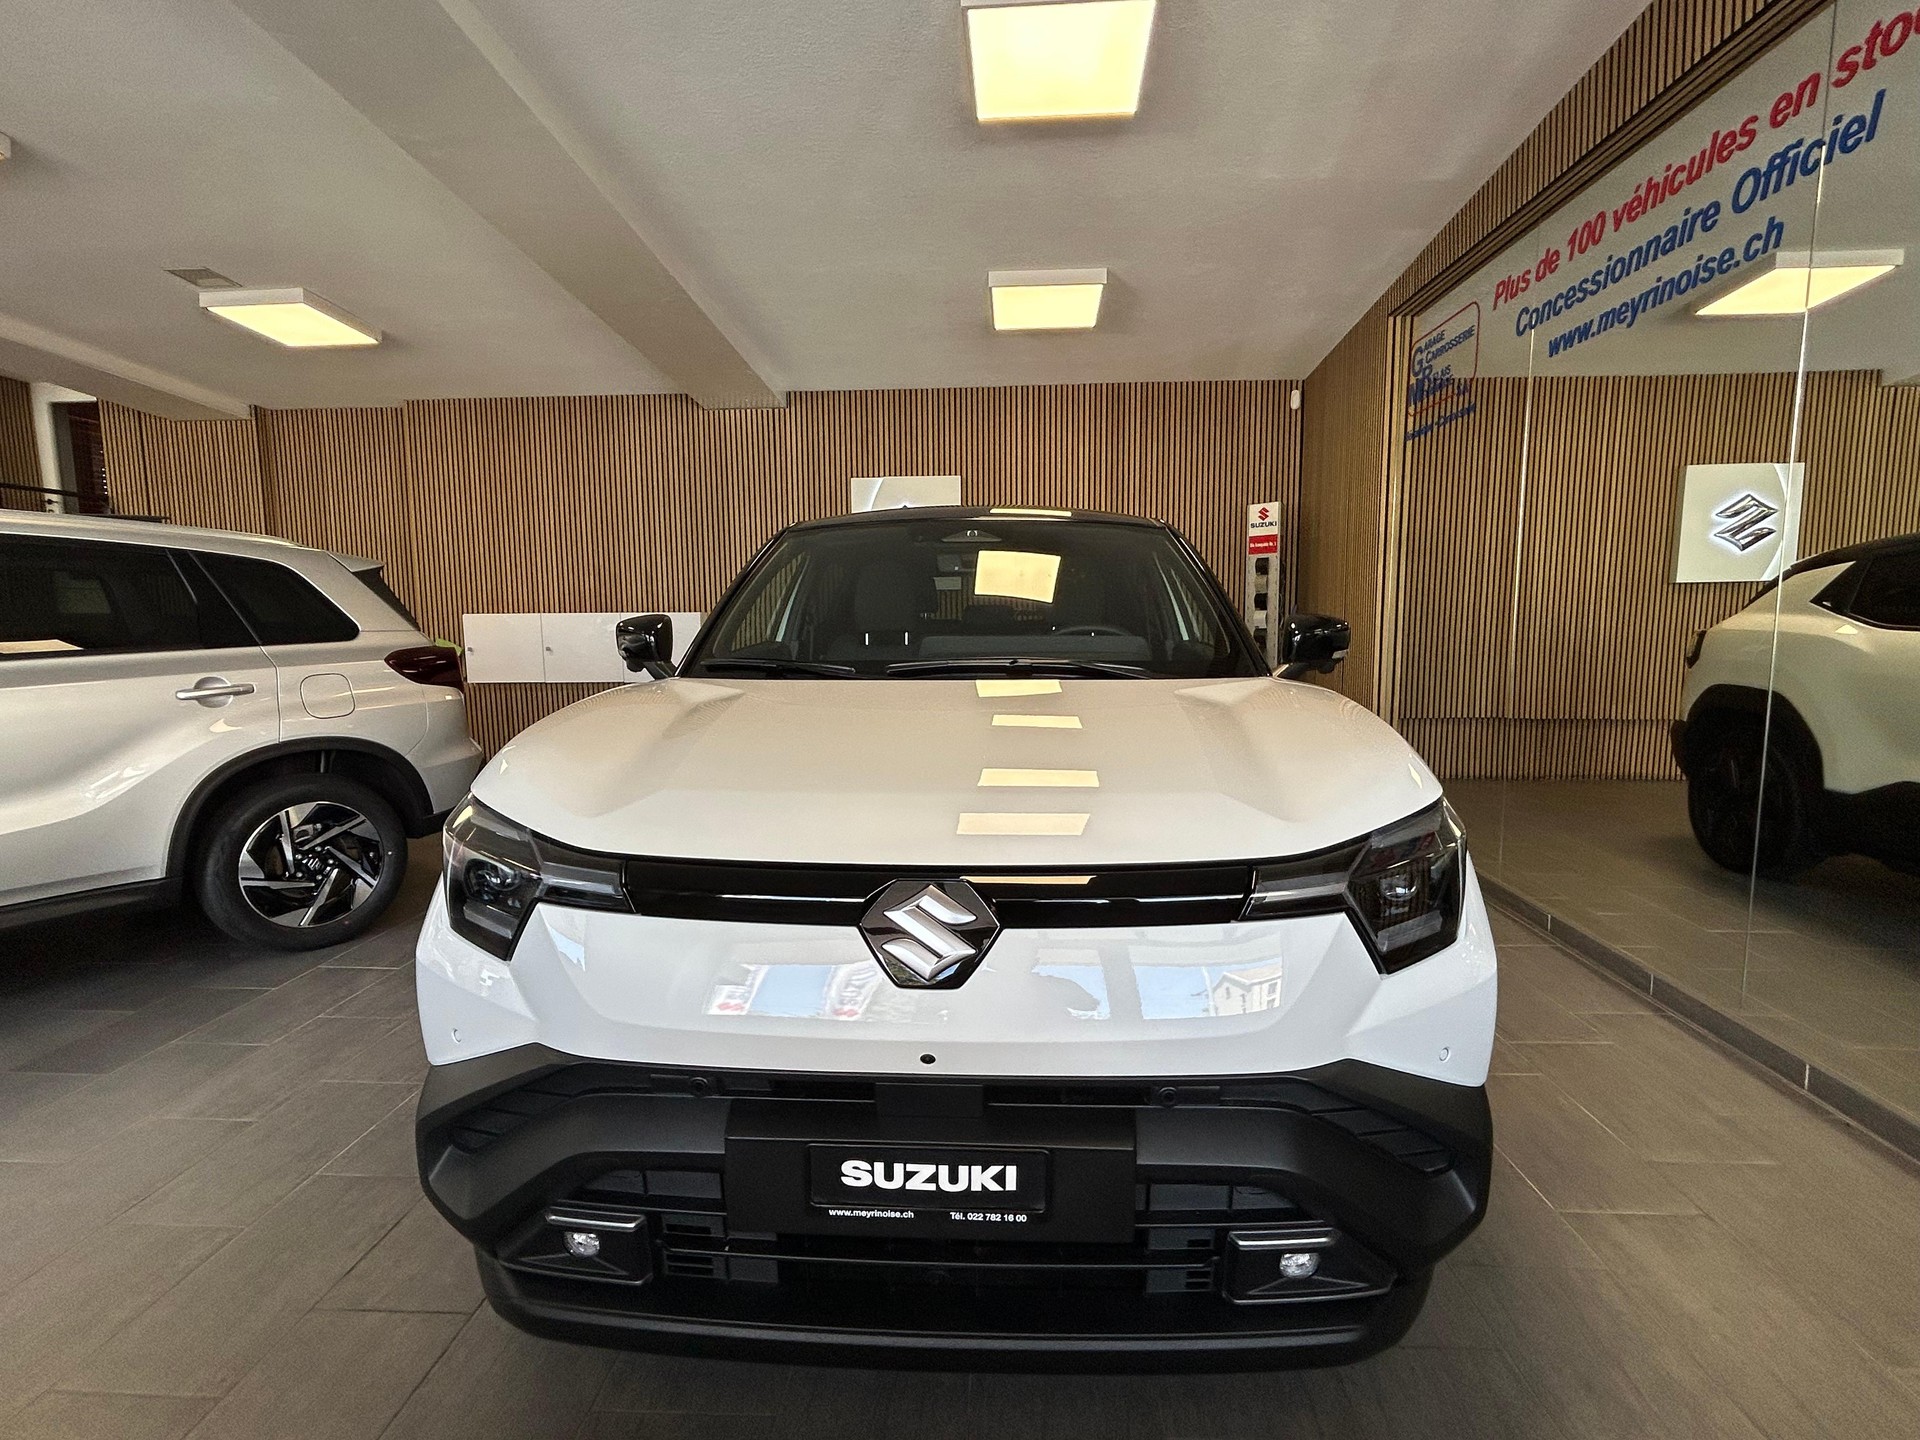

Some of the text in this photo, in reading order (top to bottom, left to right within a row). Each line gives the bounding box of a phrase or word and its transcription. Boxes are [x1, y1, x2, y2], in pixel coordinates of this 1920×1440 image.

[1492, 268, 1532, 311] Plus
[1535, 247, 1561, 283] de
[1566, 210, 1607, 262] 100
[1612, 115, 1759, 233] véhicules
[1769, 72, 1821, 129] en
[1515, 88, 1887, 337] Concessionnaire Officiel
[1547, 215, 1785, 358] www.meyrinoise.ch
[1250, 520, 1278, 529] SUZUKI
[840, 1159, 1018, 1193] SUZUKI
[828, 1209, 915, 1219] www.meyrinoise.ch
[966, 1212, 984, 1221] 022
[985, 1213, 1001, 1222] 782
[1015, 1214, 1028, 1223] 00
